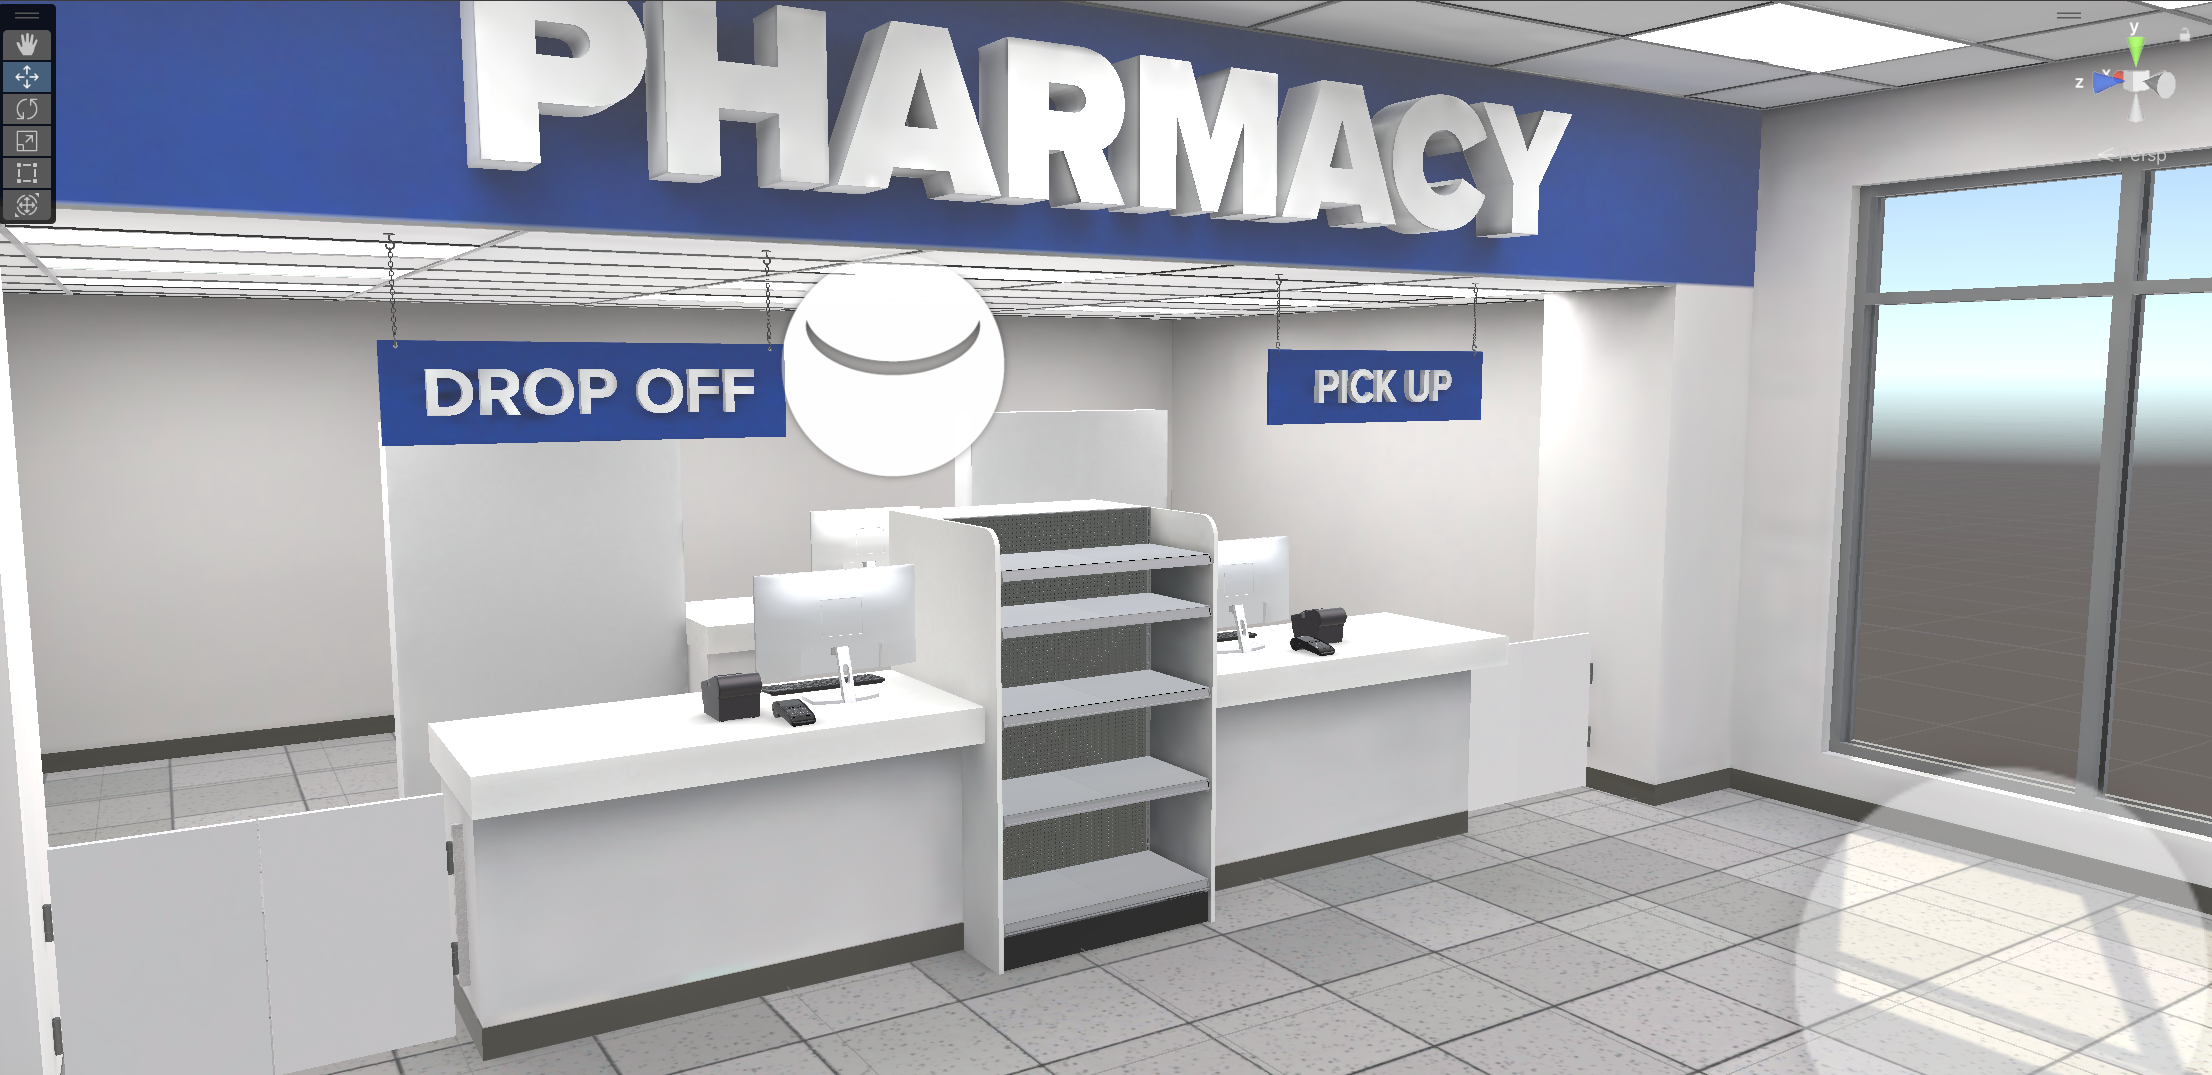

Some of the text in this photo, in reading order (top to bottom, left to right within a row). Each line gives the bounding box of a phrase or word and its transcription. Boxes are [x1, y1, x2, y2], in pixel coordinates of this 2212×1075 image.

[460, 0, 1572, 238] PHARMACY
[424, 368, 755, 416] DROP OFF
[1314, 369, 1452, 403] PICK UP
